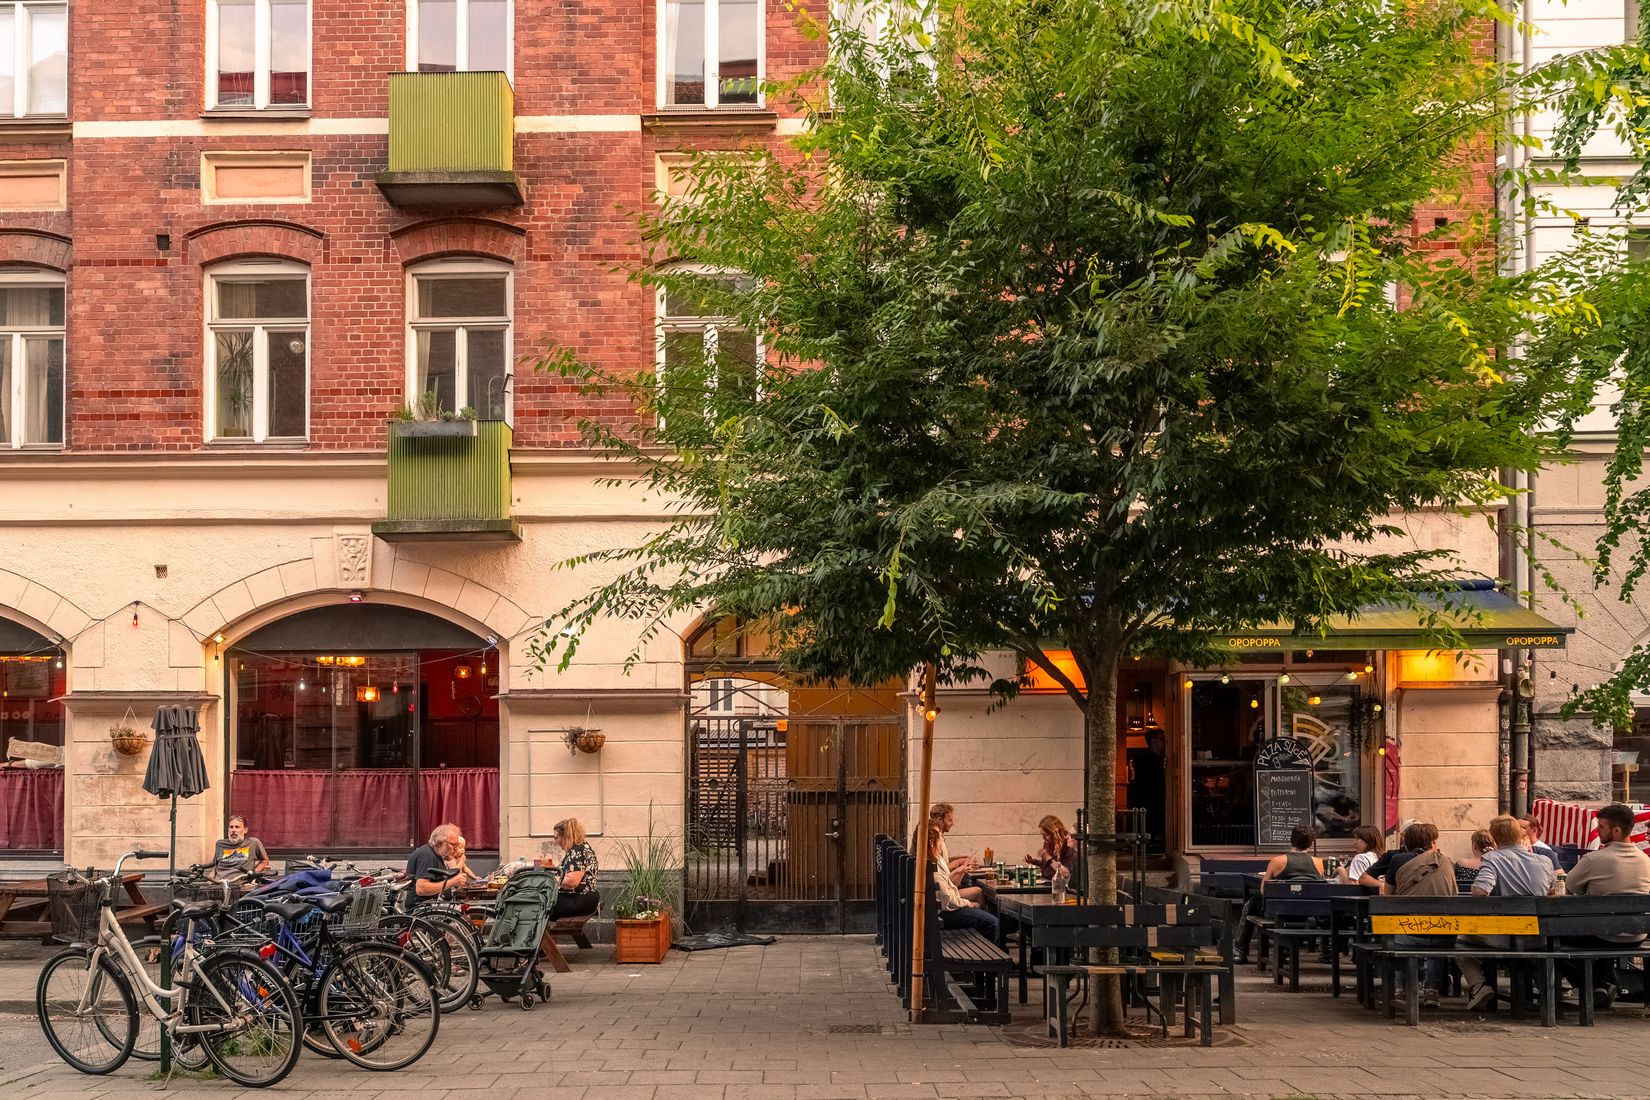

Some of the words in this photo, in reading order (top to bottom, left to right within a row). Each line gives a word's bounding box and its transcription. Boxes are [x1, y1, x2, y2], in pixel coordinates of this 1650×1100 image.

[1229, 638, 1280, 647] OPOPOPPA
[1506, 636, 1558, 646] OPOPOPPA
[1257, 742, 1282, 767] PIZZA
